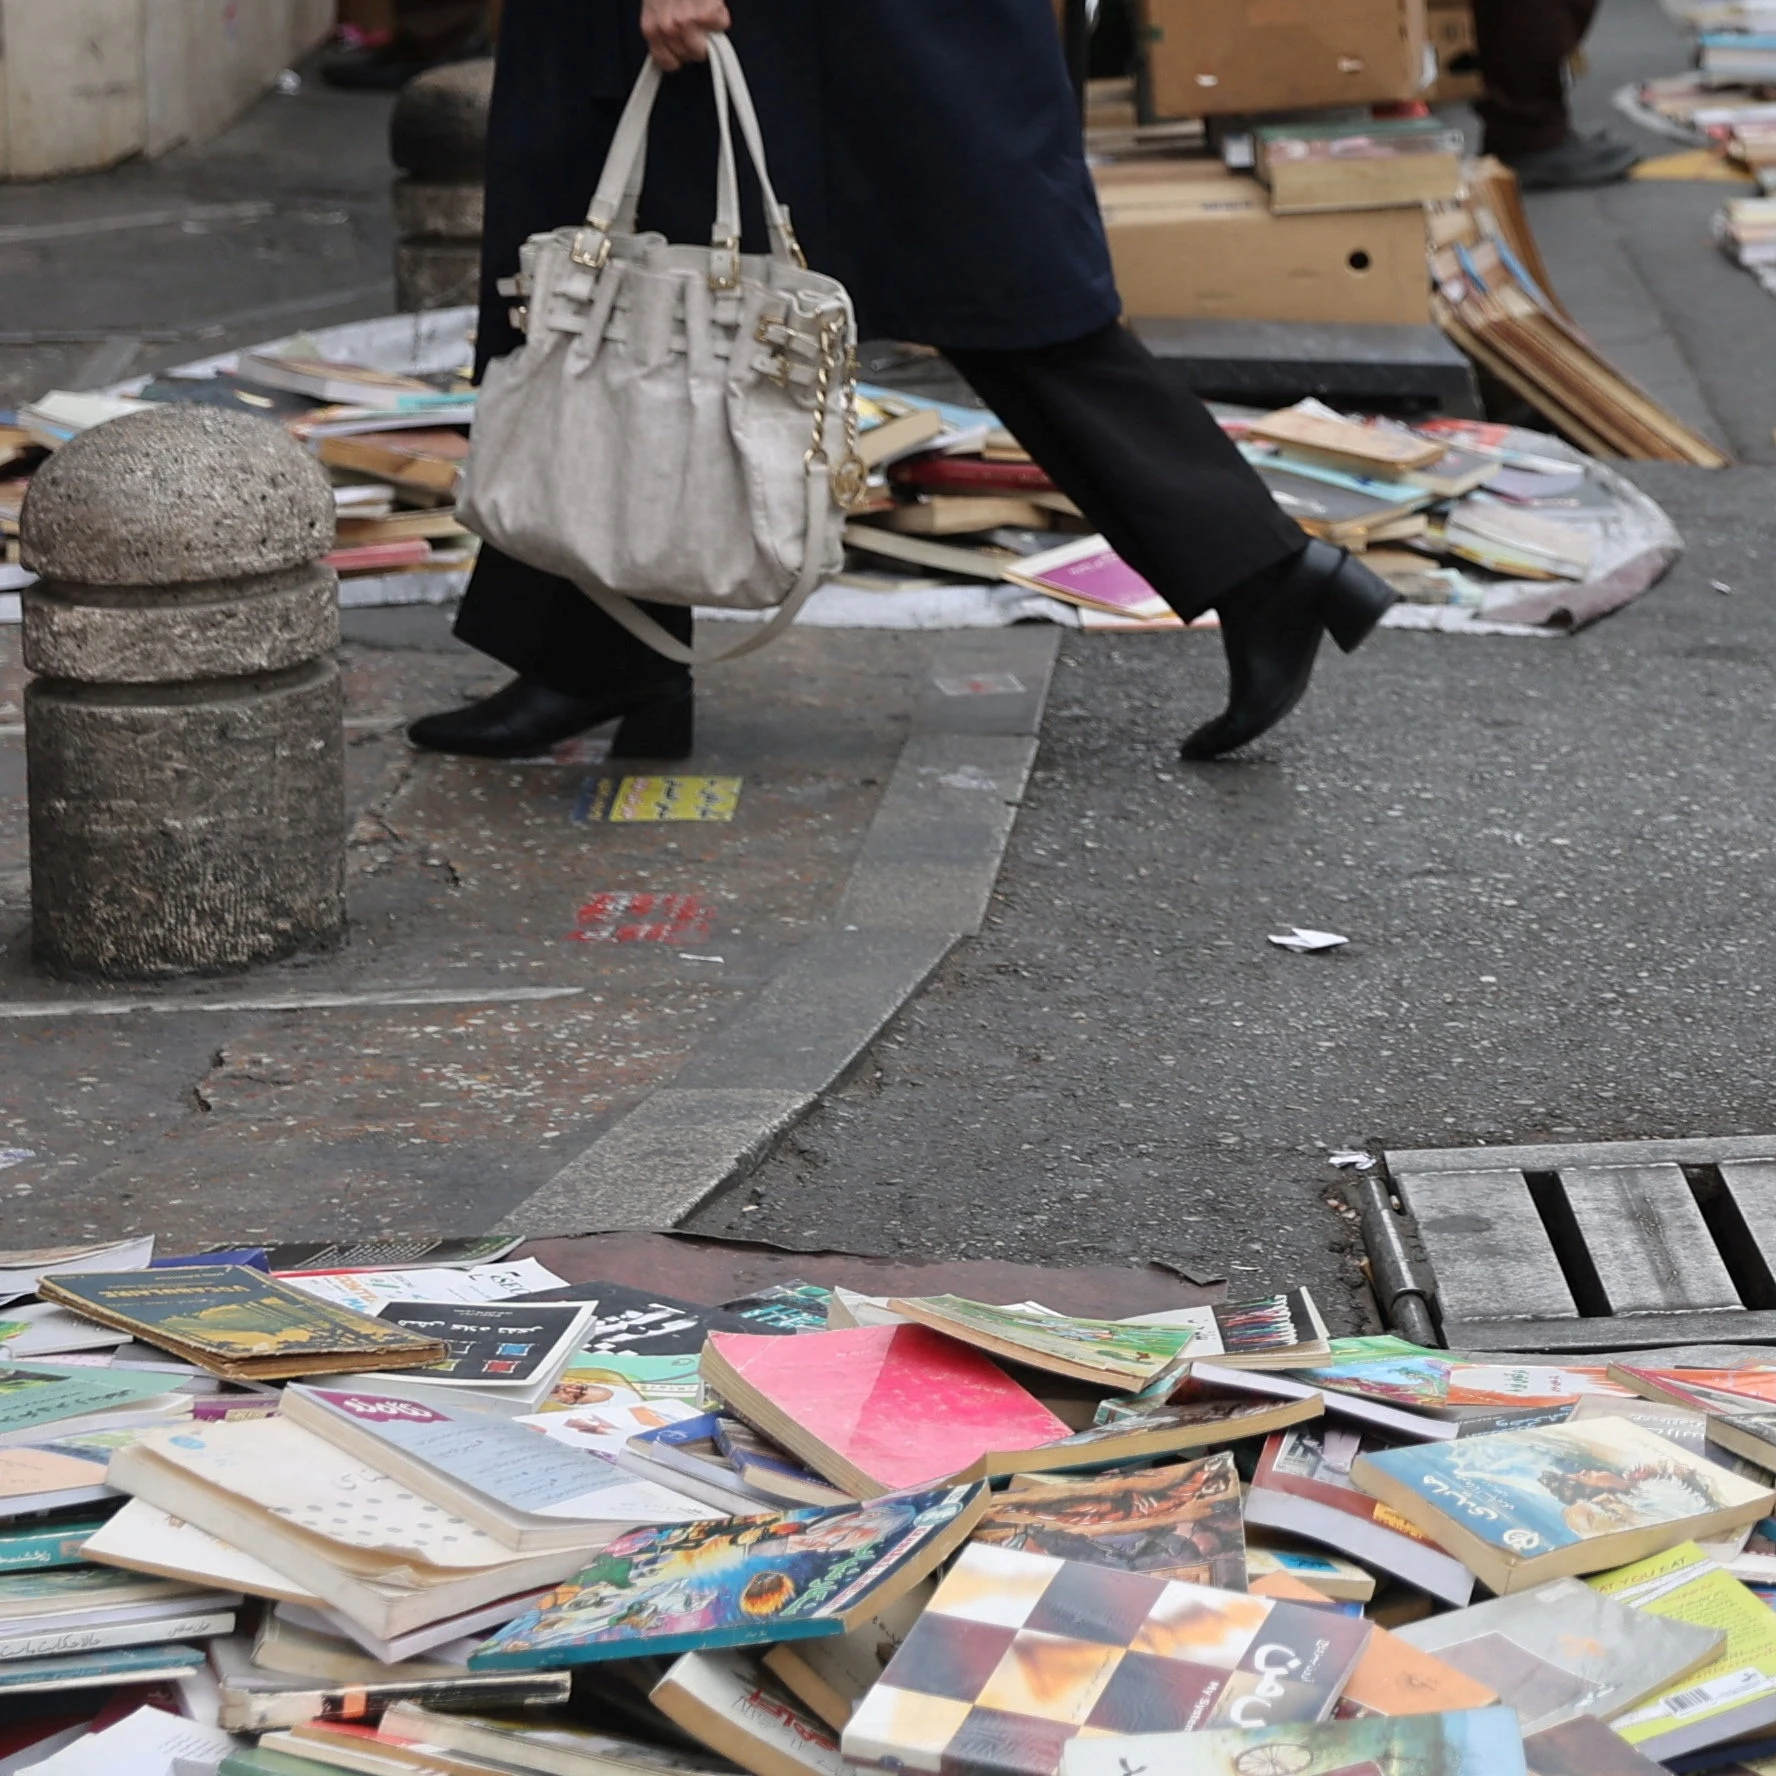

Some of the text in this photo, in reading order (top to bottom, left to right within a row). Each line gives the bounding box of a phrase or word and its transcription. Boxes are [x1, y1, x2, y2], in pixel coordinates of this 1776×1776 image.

[1422, 1474, 1498, 1521] هایدی
[1617, 1567, 1655, 1586] YOU
[1659, 1556, 1688, 1574] EAT
[37, 1634, 80, 1652] حکایت
